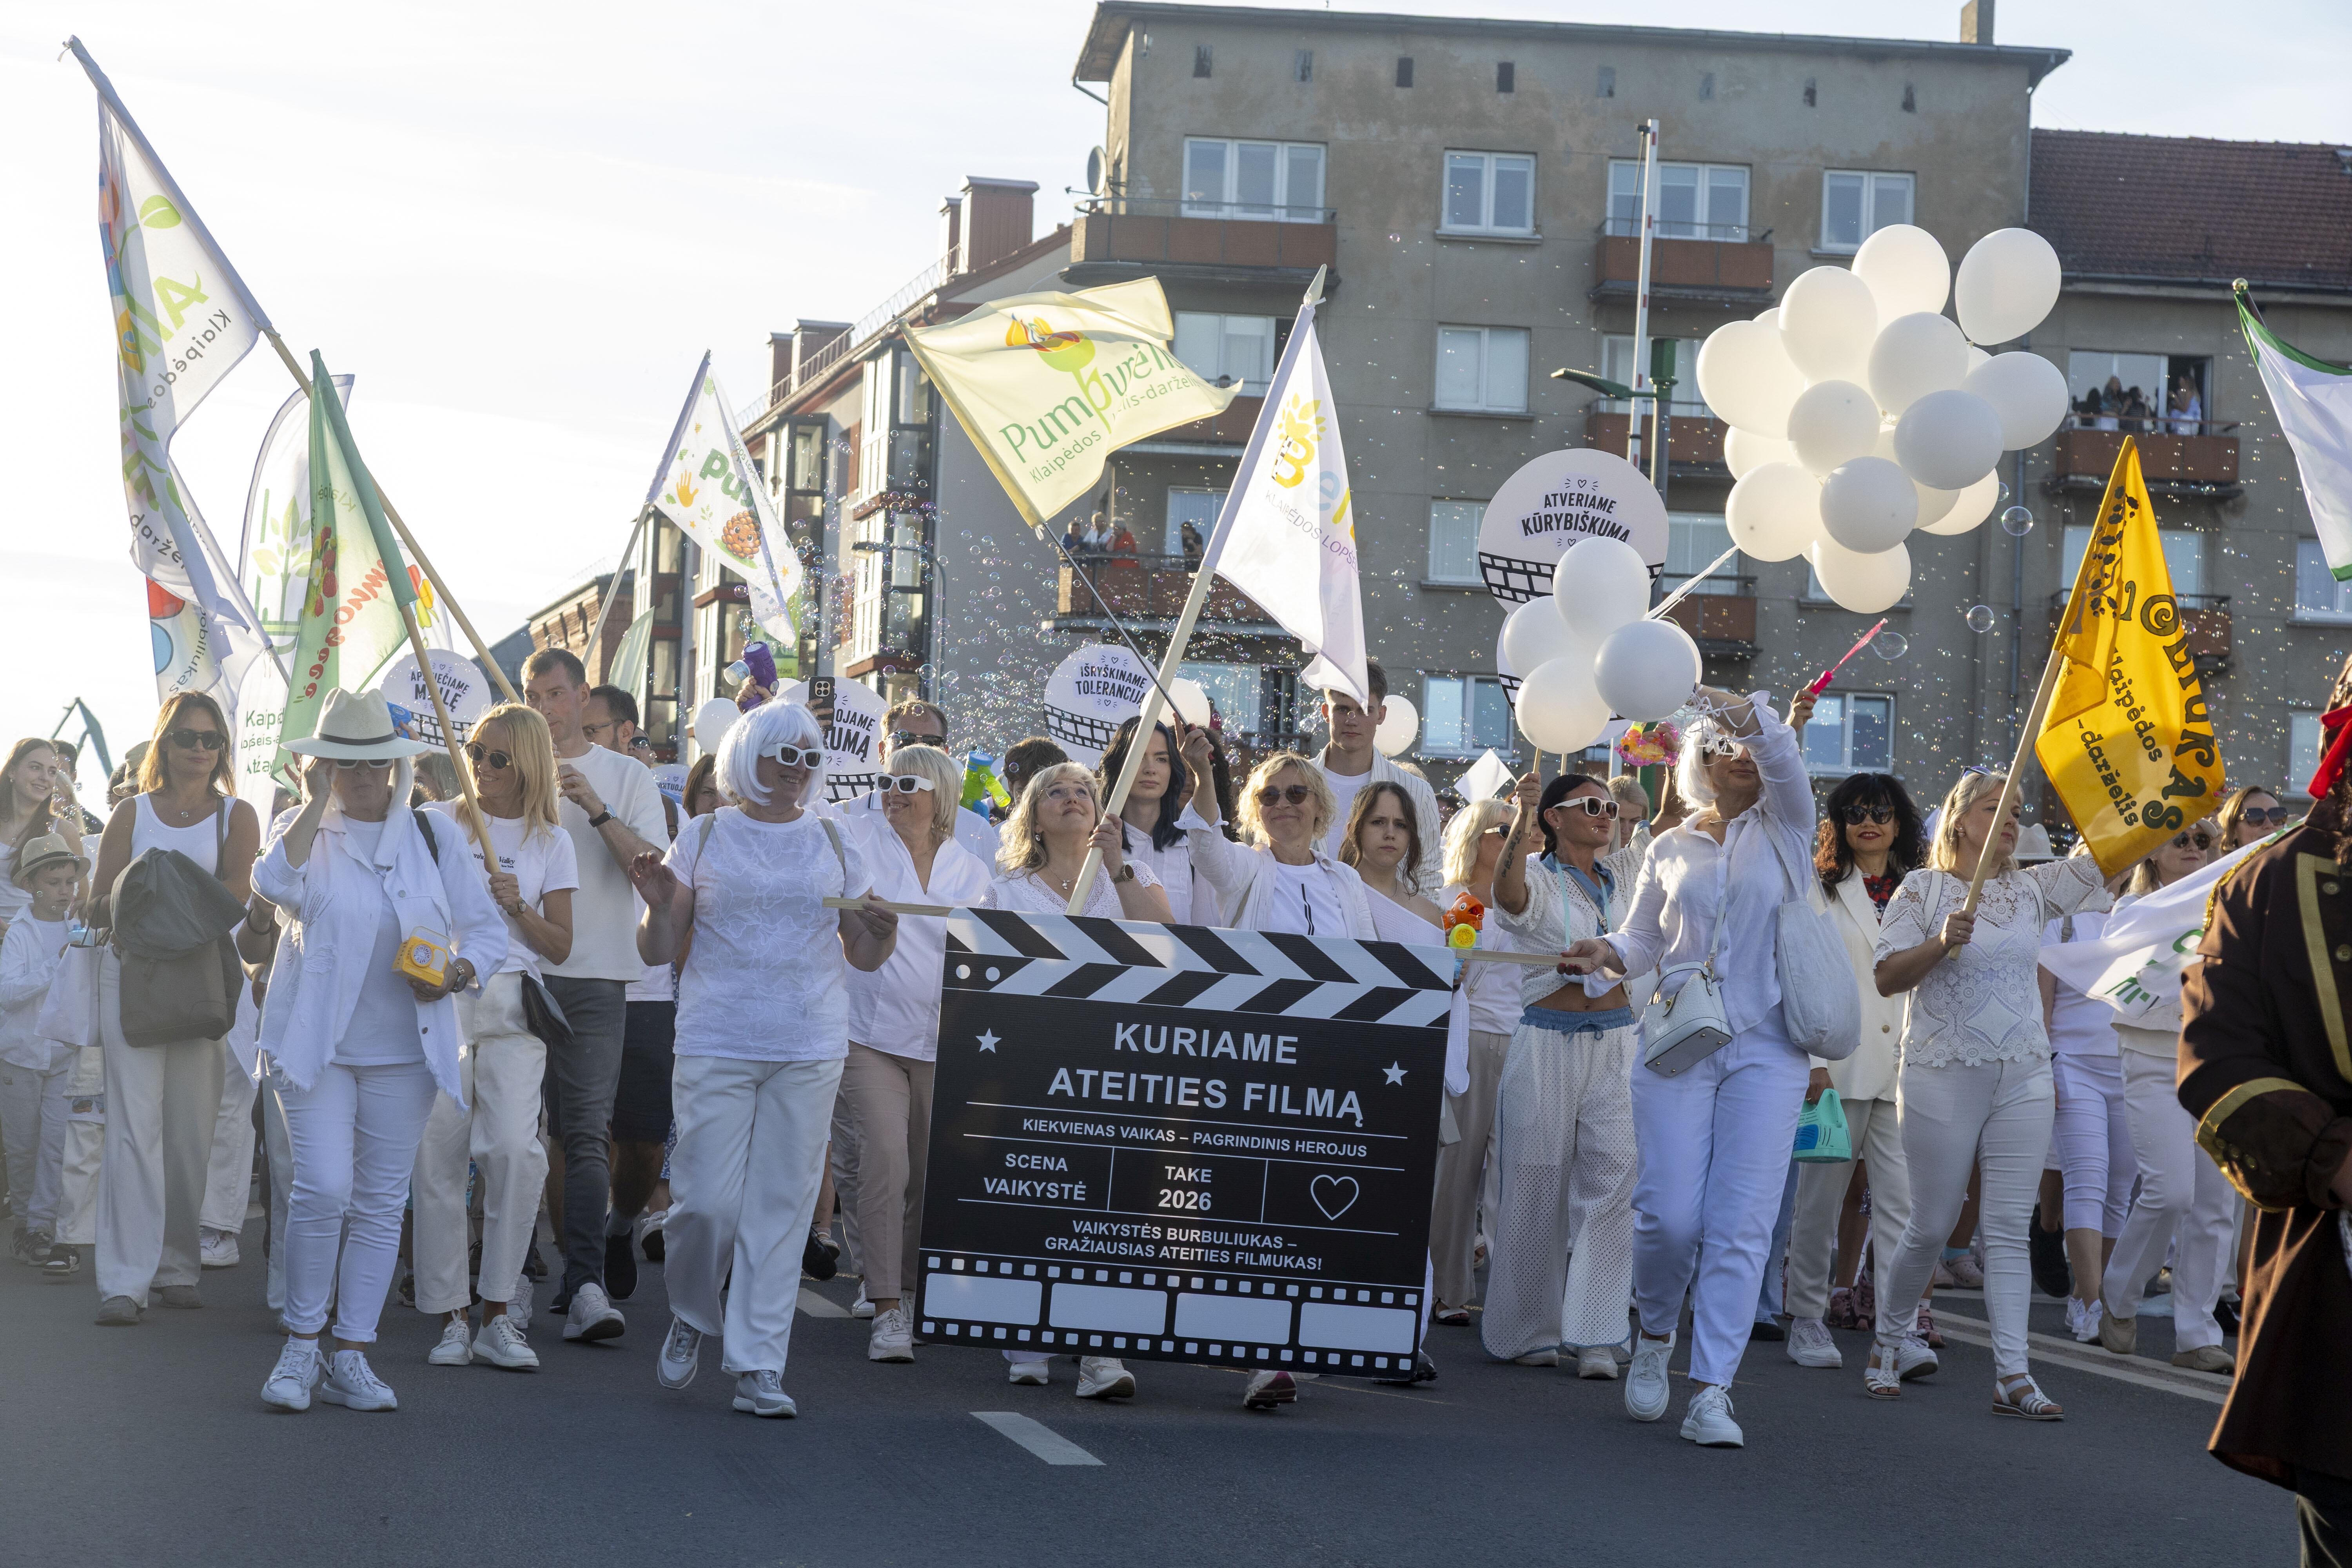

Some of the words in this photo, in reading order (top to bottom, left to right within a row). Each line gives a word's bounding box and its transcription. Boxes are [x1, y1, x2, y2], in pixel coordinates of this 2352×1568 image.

[1029, 430, 1102, 484] Klaipėdos
[1544, 492, 1617, 514] ATVERIAME
[1265, 490, 1322, 539] KLAIPĖDOS
[1321, 535, 1359, 575] LOPŠEL
[1080, 663, 1147, 689] IŠRYŠKINAME
[2110, 647, 2163, 762] laipėdos
[833, 708, 876, 732] OJAME
[499, 856, 515, 865] Valley
[1114, 1022, 1298, 1065] KURIAME
[1047, 1067, 1227, 1109] ATEITIES
[1243, 1082, 1364, 1128] FILMĄ
[1023, 1118, 1115, 1137] KIEKVIENAS
[1120, 1126, 1176, 1142] VAIKAS
[1193, 1132, 1290, 1151] PAGRINDINIS
[1295, 1140, 1367, 1157] HEROJUS
[1005, 1153, 1068, 1172] SCENA
[1164, 1165, 1212, 1183] TAKE
[983, 1177, 1087, 1201] VAIKYSTĖ
[1158, 1188, 1212, 1211] 2026
[1072, 1220, 1162, 1240] VAIKYSTĖS
[1166, 1227, 1283, 1249] BURBULIUKAS
[1045, 1236, 1155, 1258] GRAŽIAUSIAS
[1158, 1245, 1230, 1263] ATEITIES
[1235, 1251, 1322, 1270] FILMUKAS!
